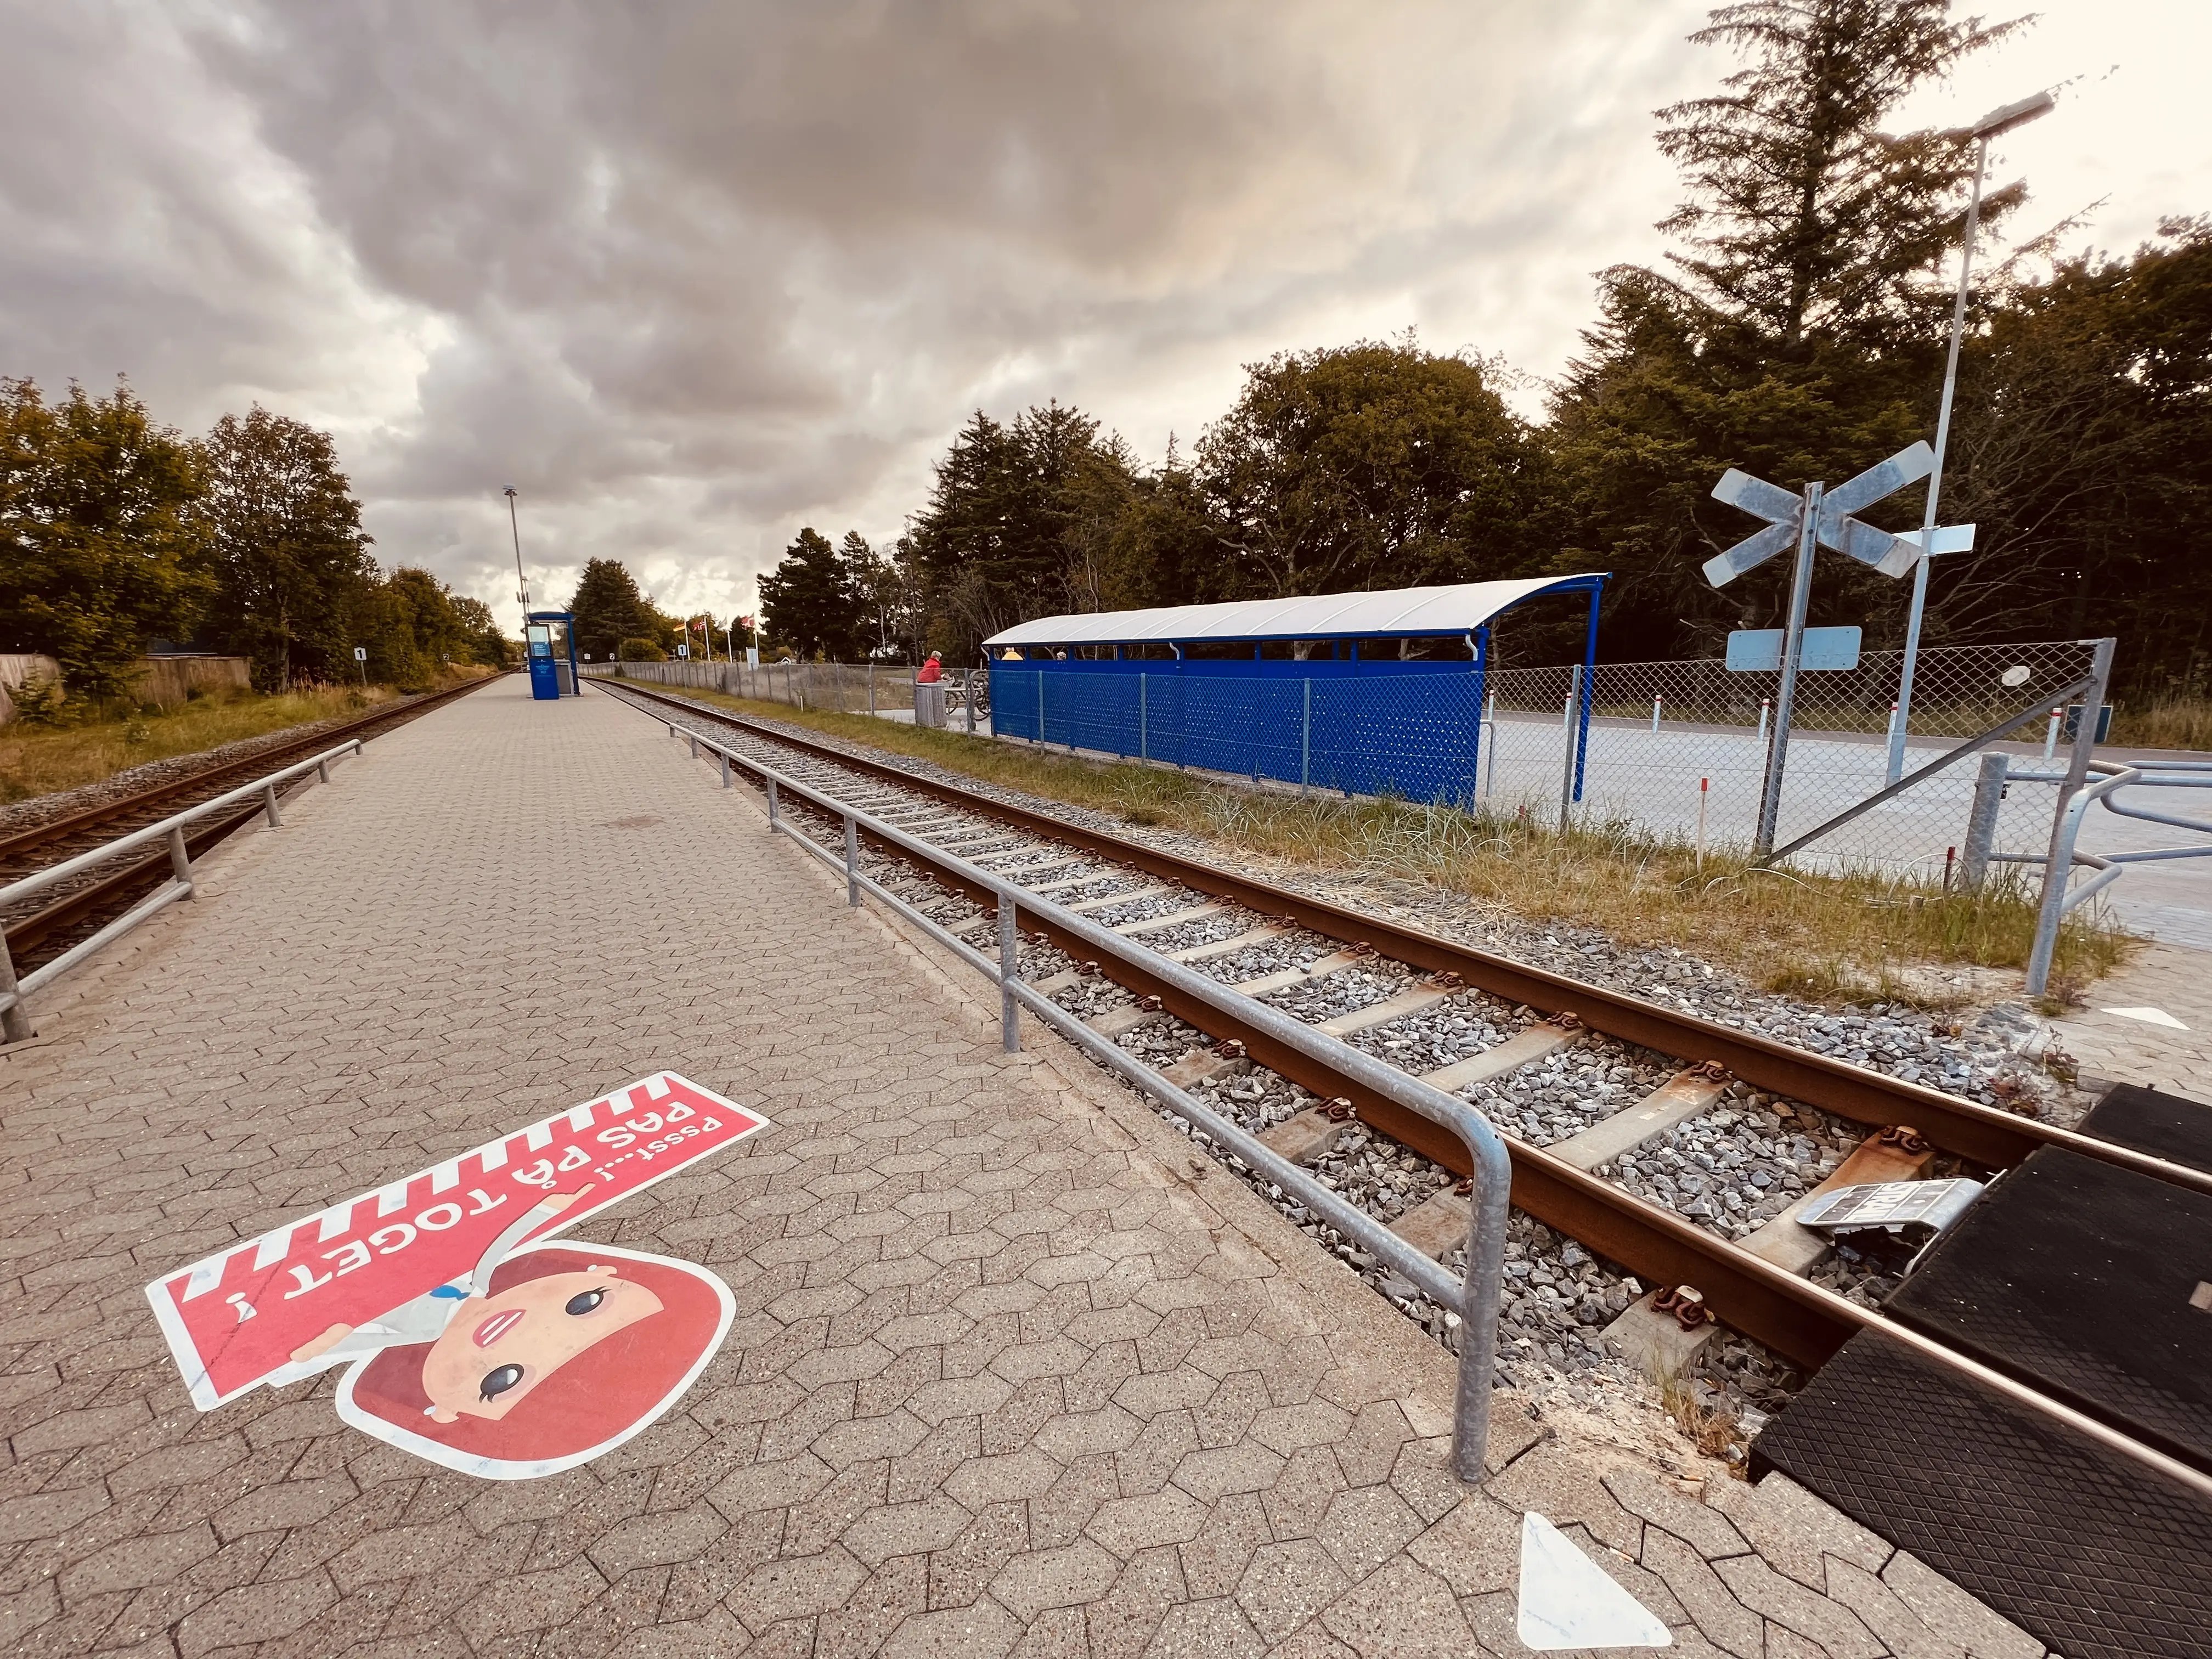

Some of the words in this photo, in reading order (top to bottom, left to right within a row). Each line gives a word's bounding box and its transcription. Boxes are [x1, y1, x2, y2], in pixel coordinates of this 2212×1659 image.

[357, 650, 363, 658] 1
[597, 1101, 696, 1149] PAS
[511, 1145, 592, 1189] PÅ
